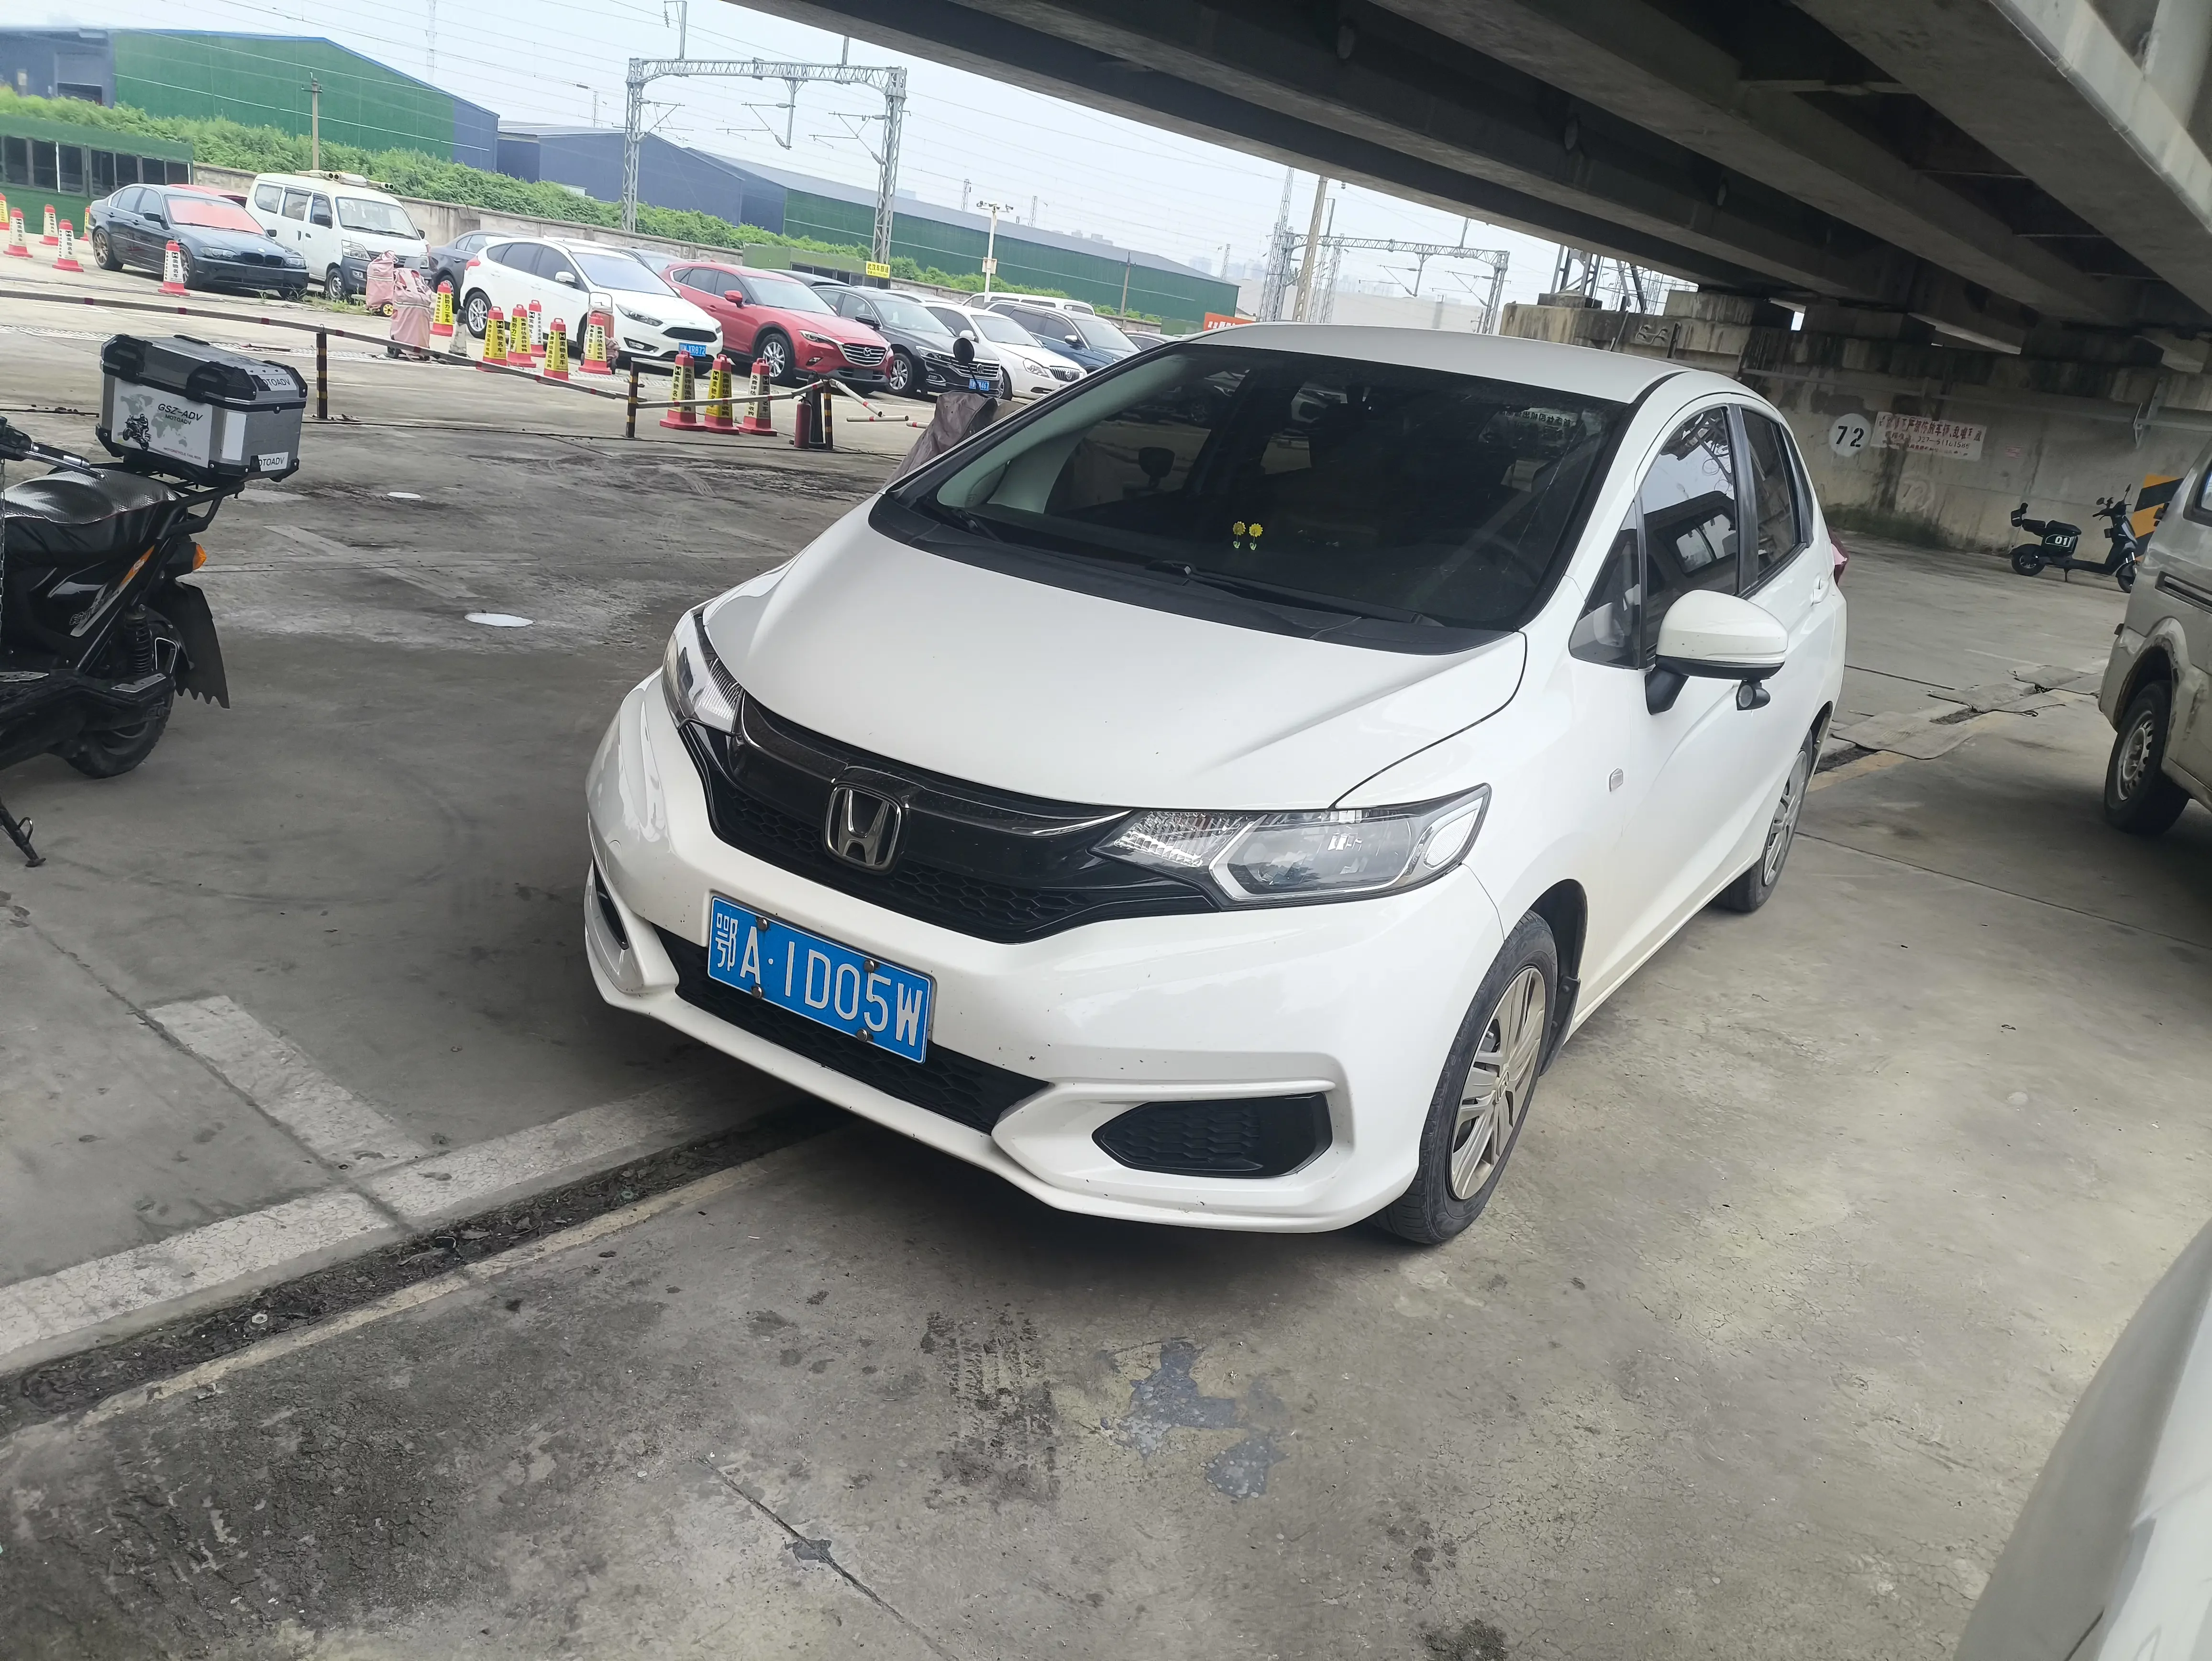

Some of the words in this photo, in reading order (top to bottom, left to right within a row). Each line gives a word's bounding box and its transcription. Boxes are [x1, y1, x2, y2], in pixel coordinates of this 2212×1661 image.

[684, 367, 692, 412] 免费评估高价购
[748, 375, 759, 416] 免费评估价收购
[158, 403, 203, 421] GSZ-ADV
[165, 413, 192, 425] MOTOADV
[1836, 425, 1864, 448] 72
[2055, 536, 2068, 545] 01
[715, 912, 923, 1047] 鄂A·1D05W
